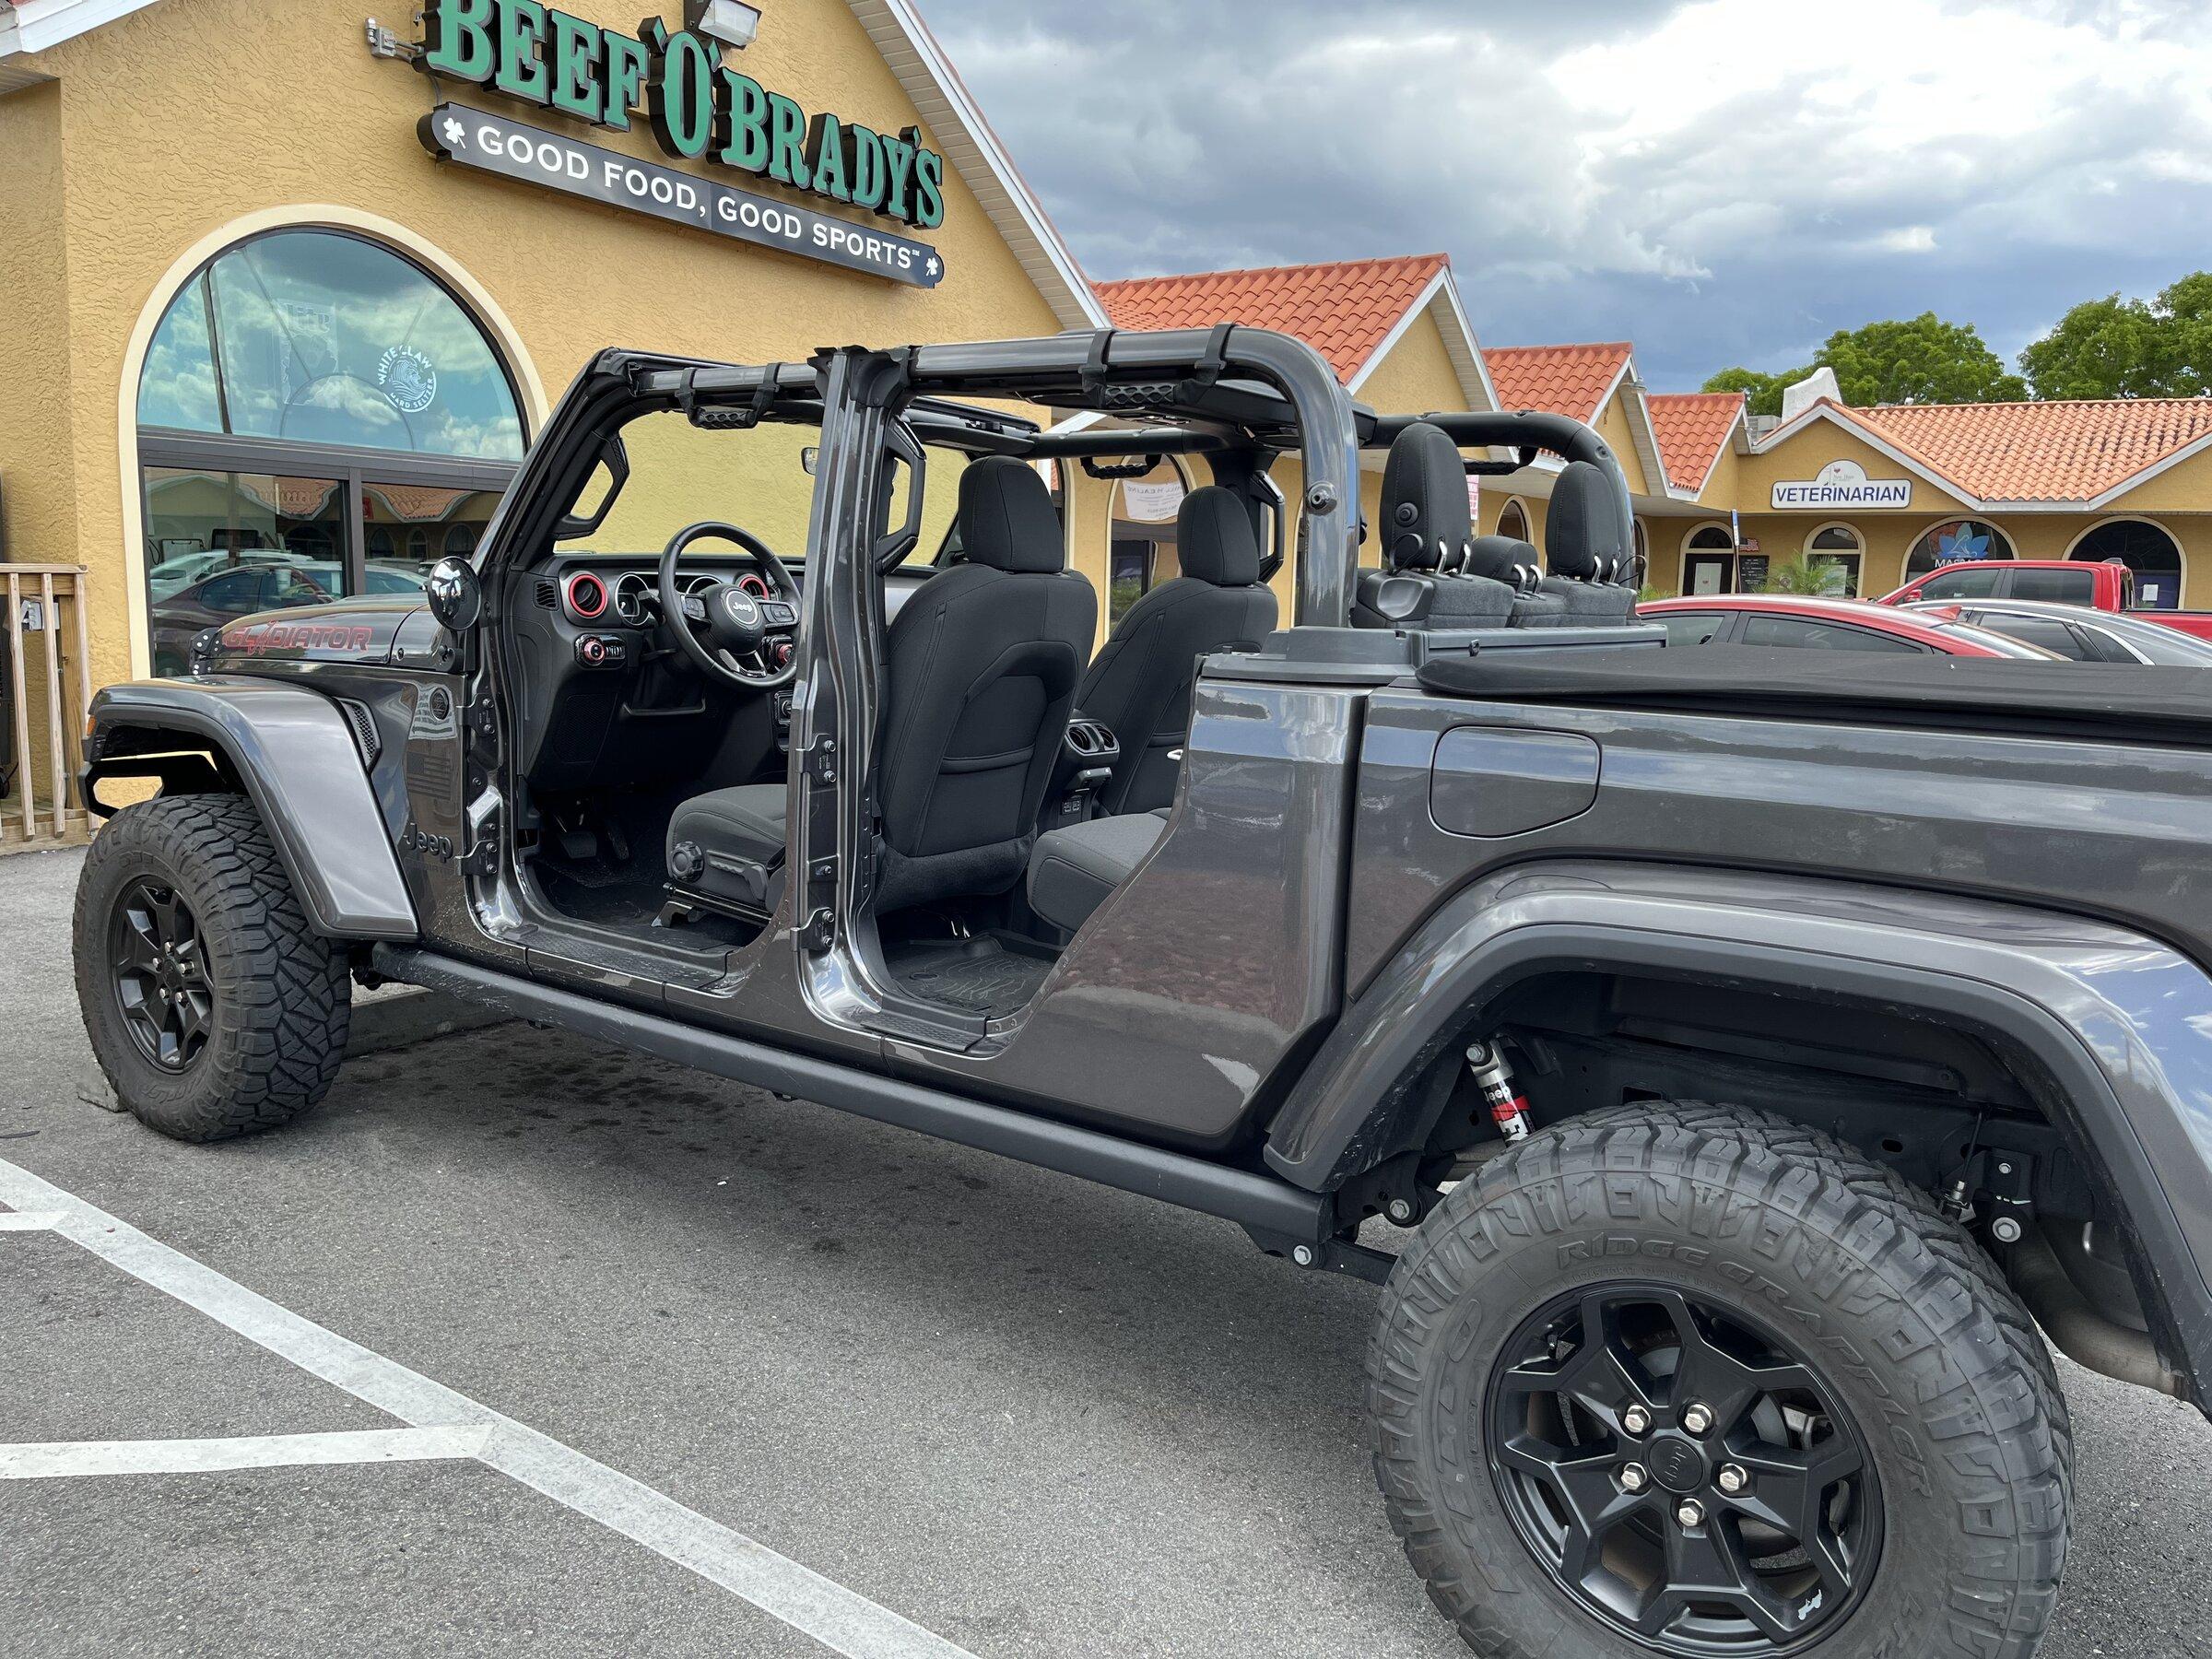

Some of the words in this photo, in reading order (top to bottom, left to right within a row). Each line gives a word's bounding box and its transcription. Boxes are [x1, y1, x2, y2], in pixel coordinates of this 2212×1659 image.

[426, 0, 650, 132] BEEF
[721, 66, 944, 229] BRADY'S
[477, 125, 590, 180] GOOD
[604, 160, 707, 218] FOOD,
[717, 195, 802, 239] GOOD
[378, 347, 398, 385] WHITE
[413, 378, 433, 408] SELTZER
[1776, 486, 1906, 501] VETERINARIAN
[733, 602, 753, 613] Jeep
[404, 822, 453, 864] Jeep
[1557, 1231, 1711, 1270] RIDGE
